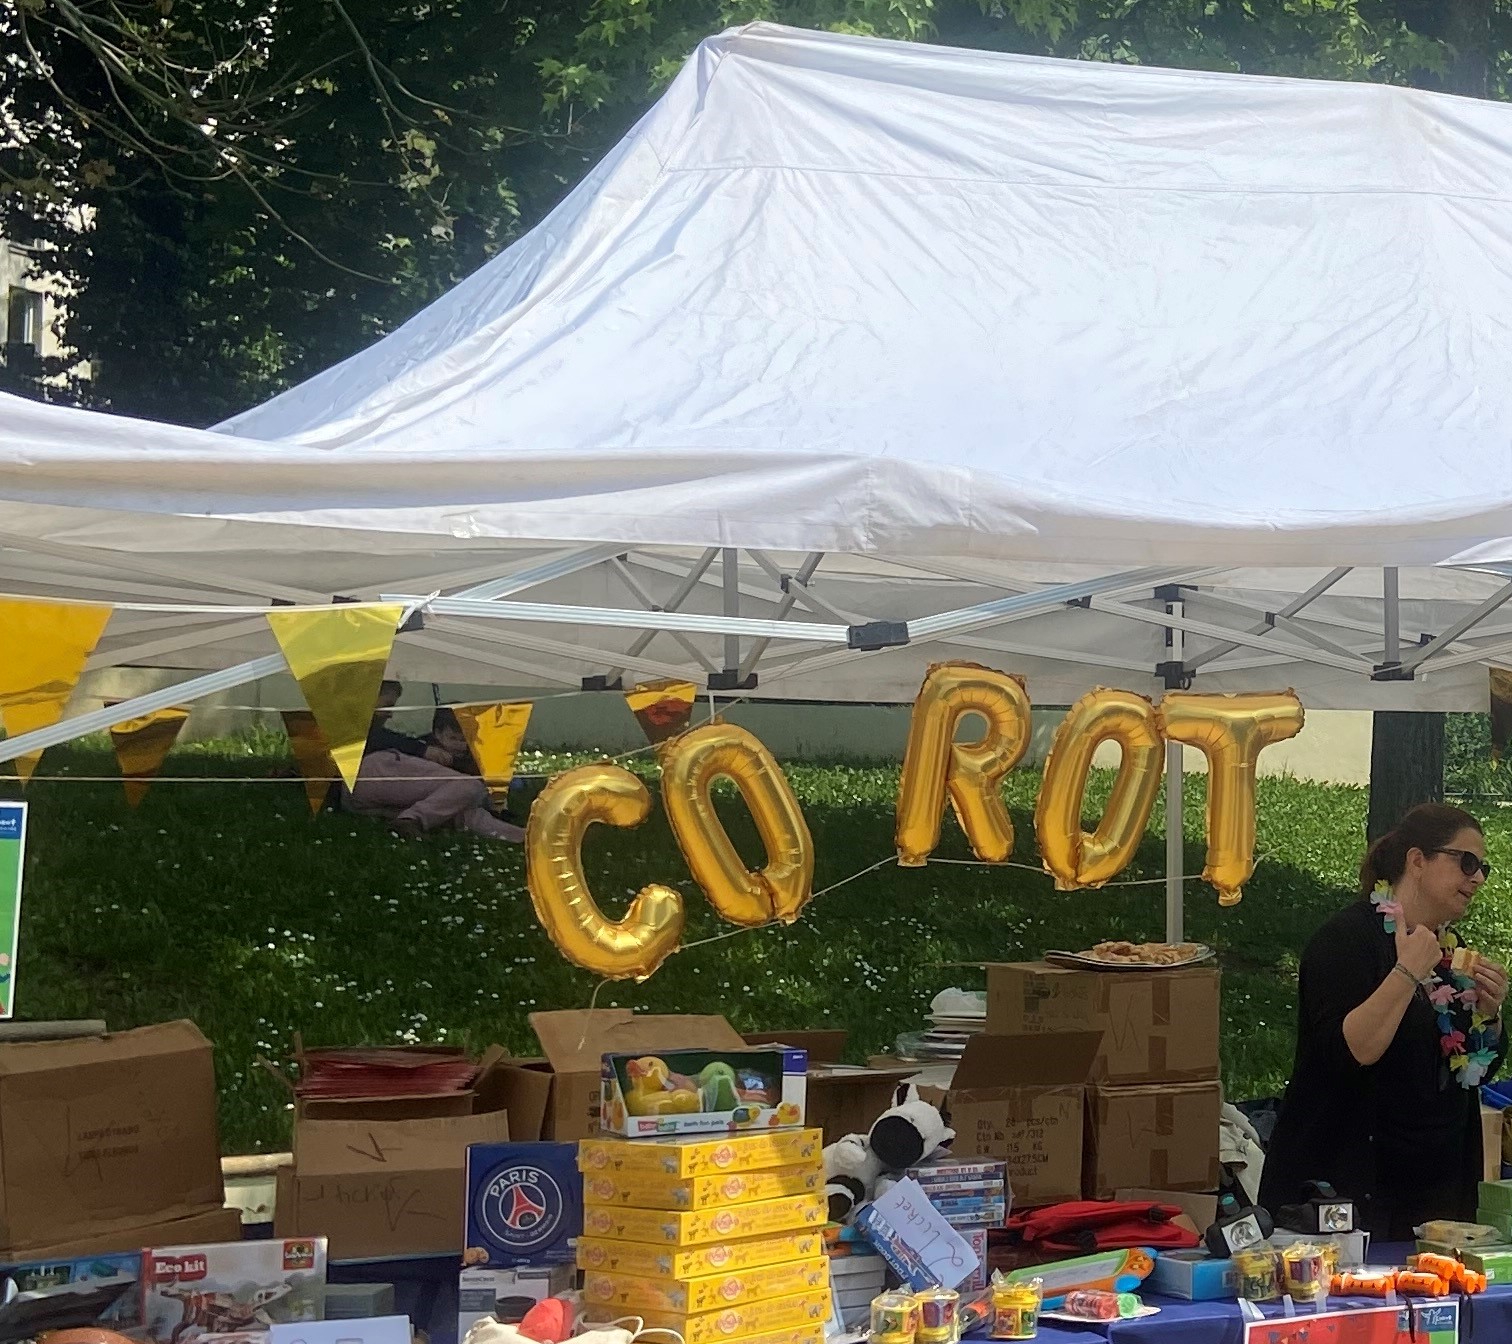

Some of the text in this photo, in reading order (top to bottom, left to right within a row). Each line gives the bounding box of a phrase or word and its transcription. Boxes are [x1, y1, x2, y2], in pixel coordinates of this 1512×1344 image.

[490, 1169, 540, 1198] PARIS
[155, 1259, 206, 1274] Eco kit
